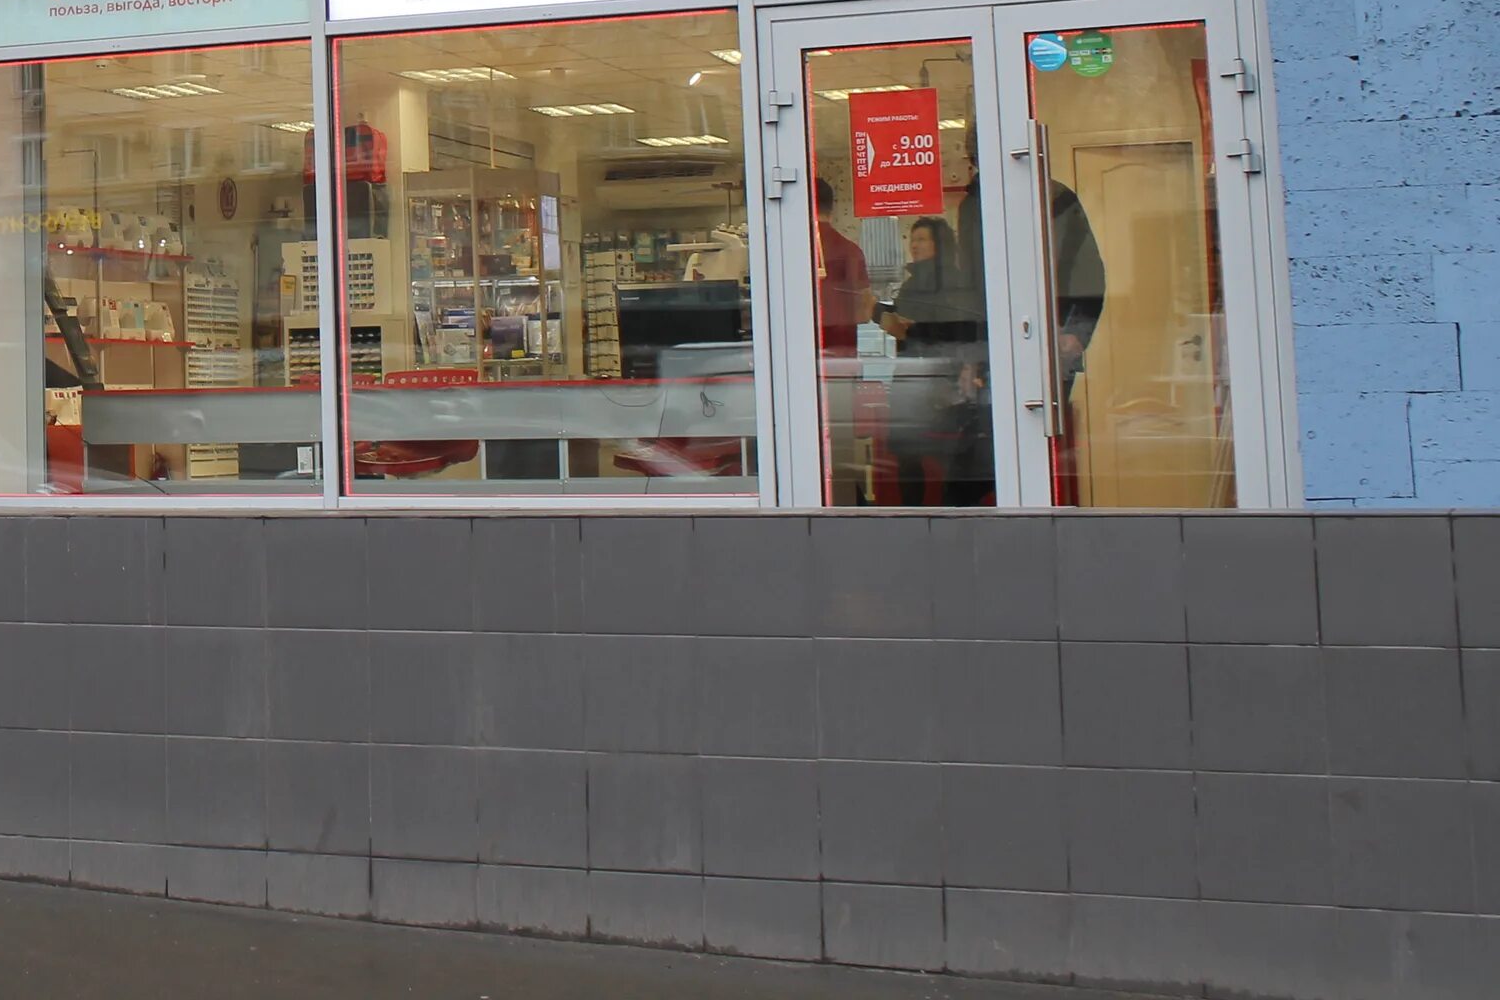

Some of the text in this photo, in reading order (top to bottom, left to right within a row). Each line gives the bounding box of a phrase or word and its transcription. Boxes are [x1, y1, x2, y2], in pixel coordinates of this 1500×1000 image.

[49, 2, 103, 17] польза,
[900, 134, 934, 150] 9.00
[892, 151, 935, 167] 21.00
[870, 183, 923, 193] ЕЖЕДНЕВНО
